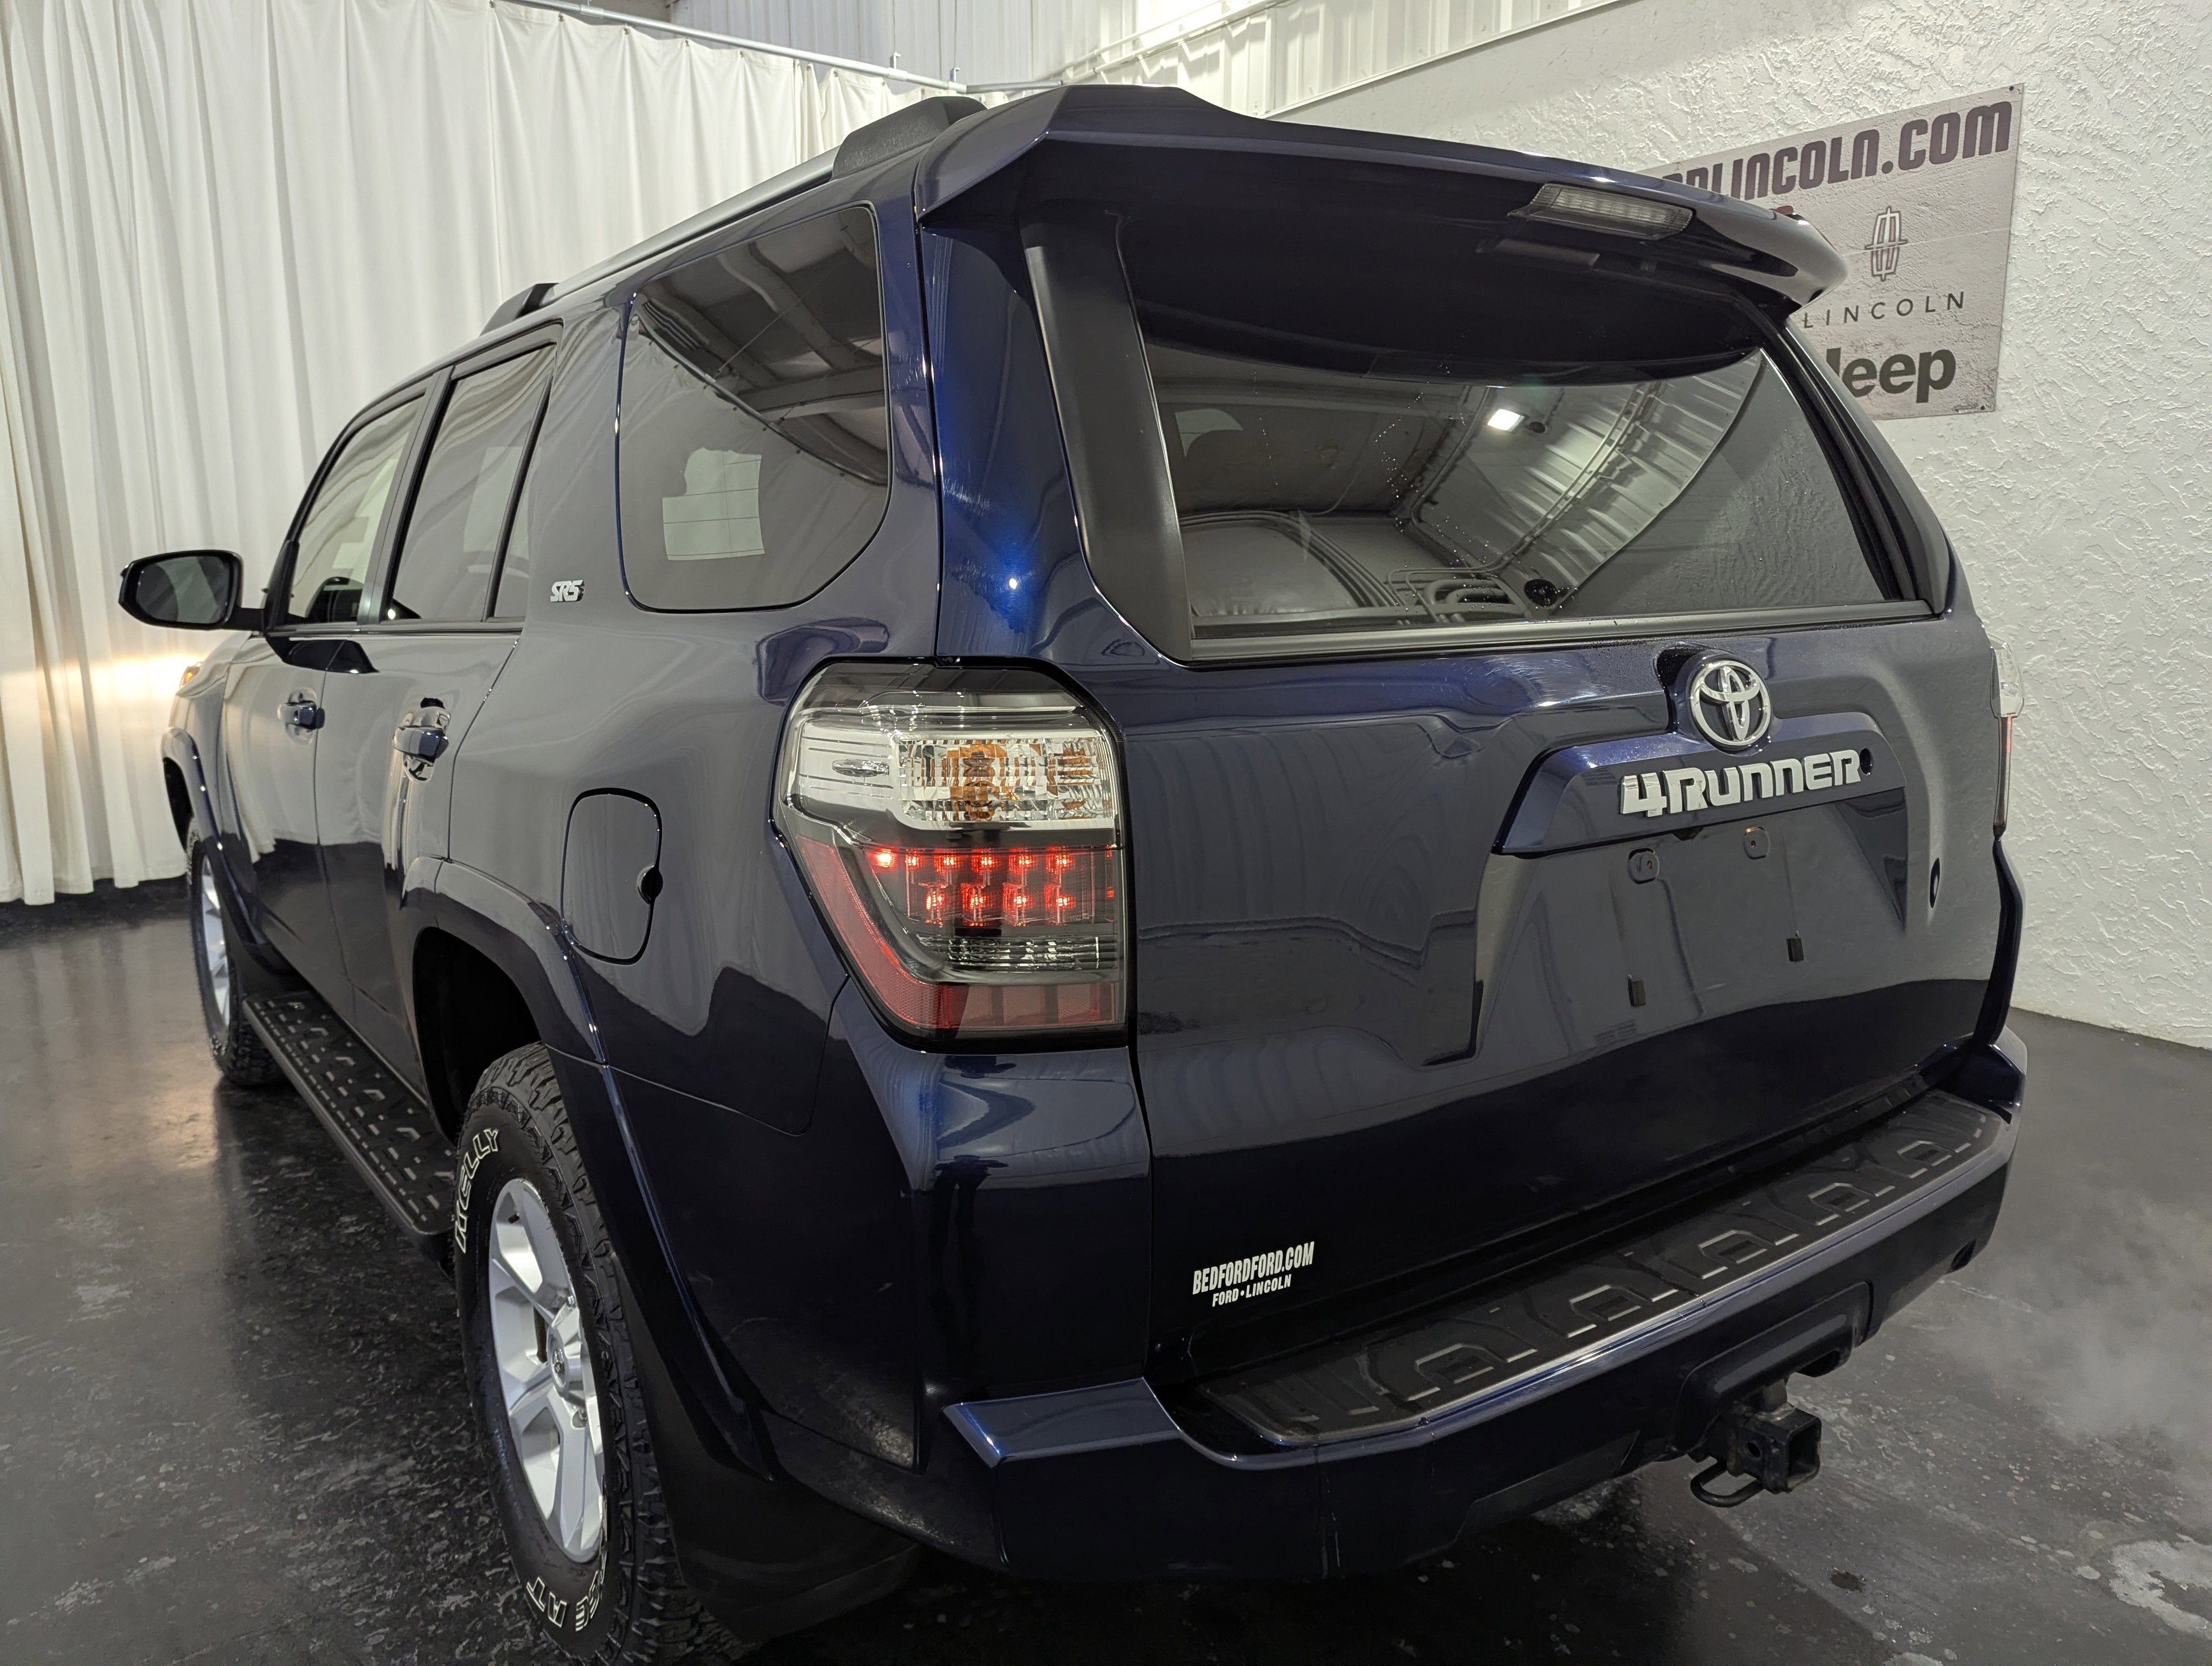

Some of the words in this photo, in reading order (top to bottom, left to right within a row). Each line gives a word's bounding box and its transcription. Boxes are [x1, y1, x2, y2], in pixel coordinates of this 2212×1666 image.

[1662, 101, 2012, 201] LINCOLN.COM
[1804, 291, 1965, 329] LINCOLN
[550, 580, 583, 602] SR5
[1620, 749, 1861, 818] 4RUNNER
[454, 1128, 499, 1254] KELLY
[1192, 1241, 1315, 1295] BEDFORDFORD.COM
